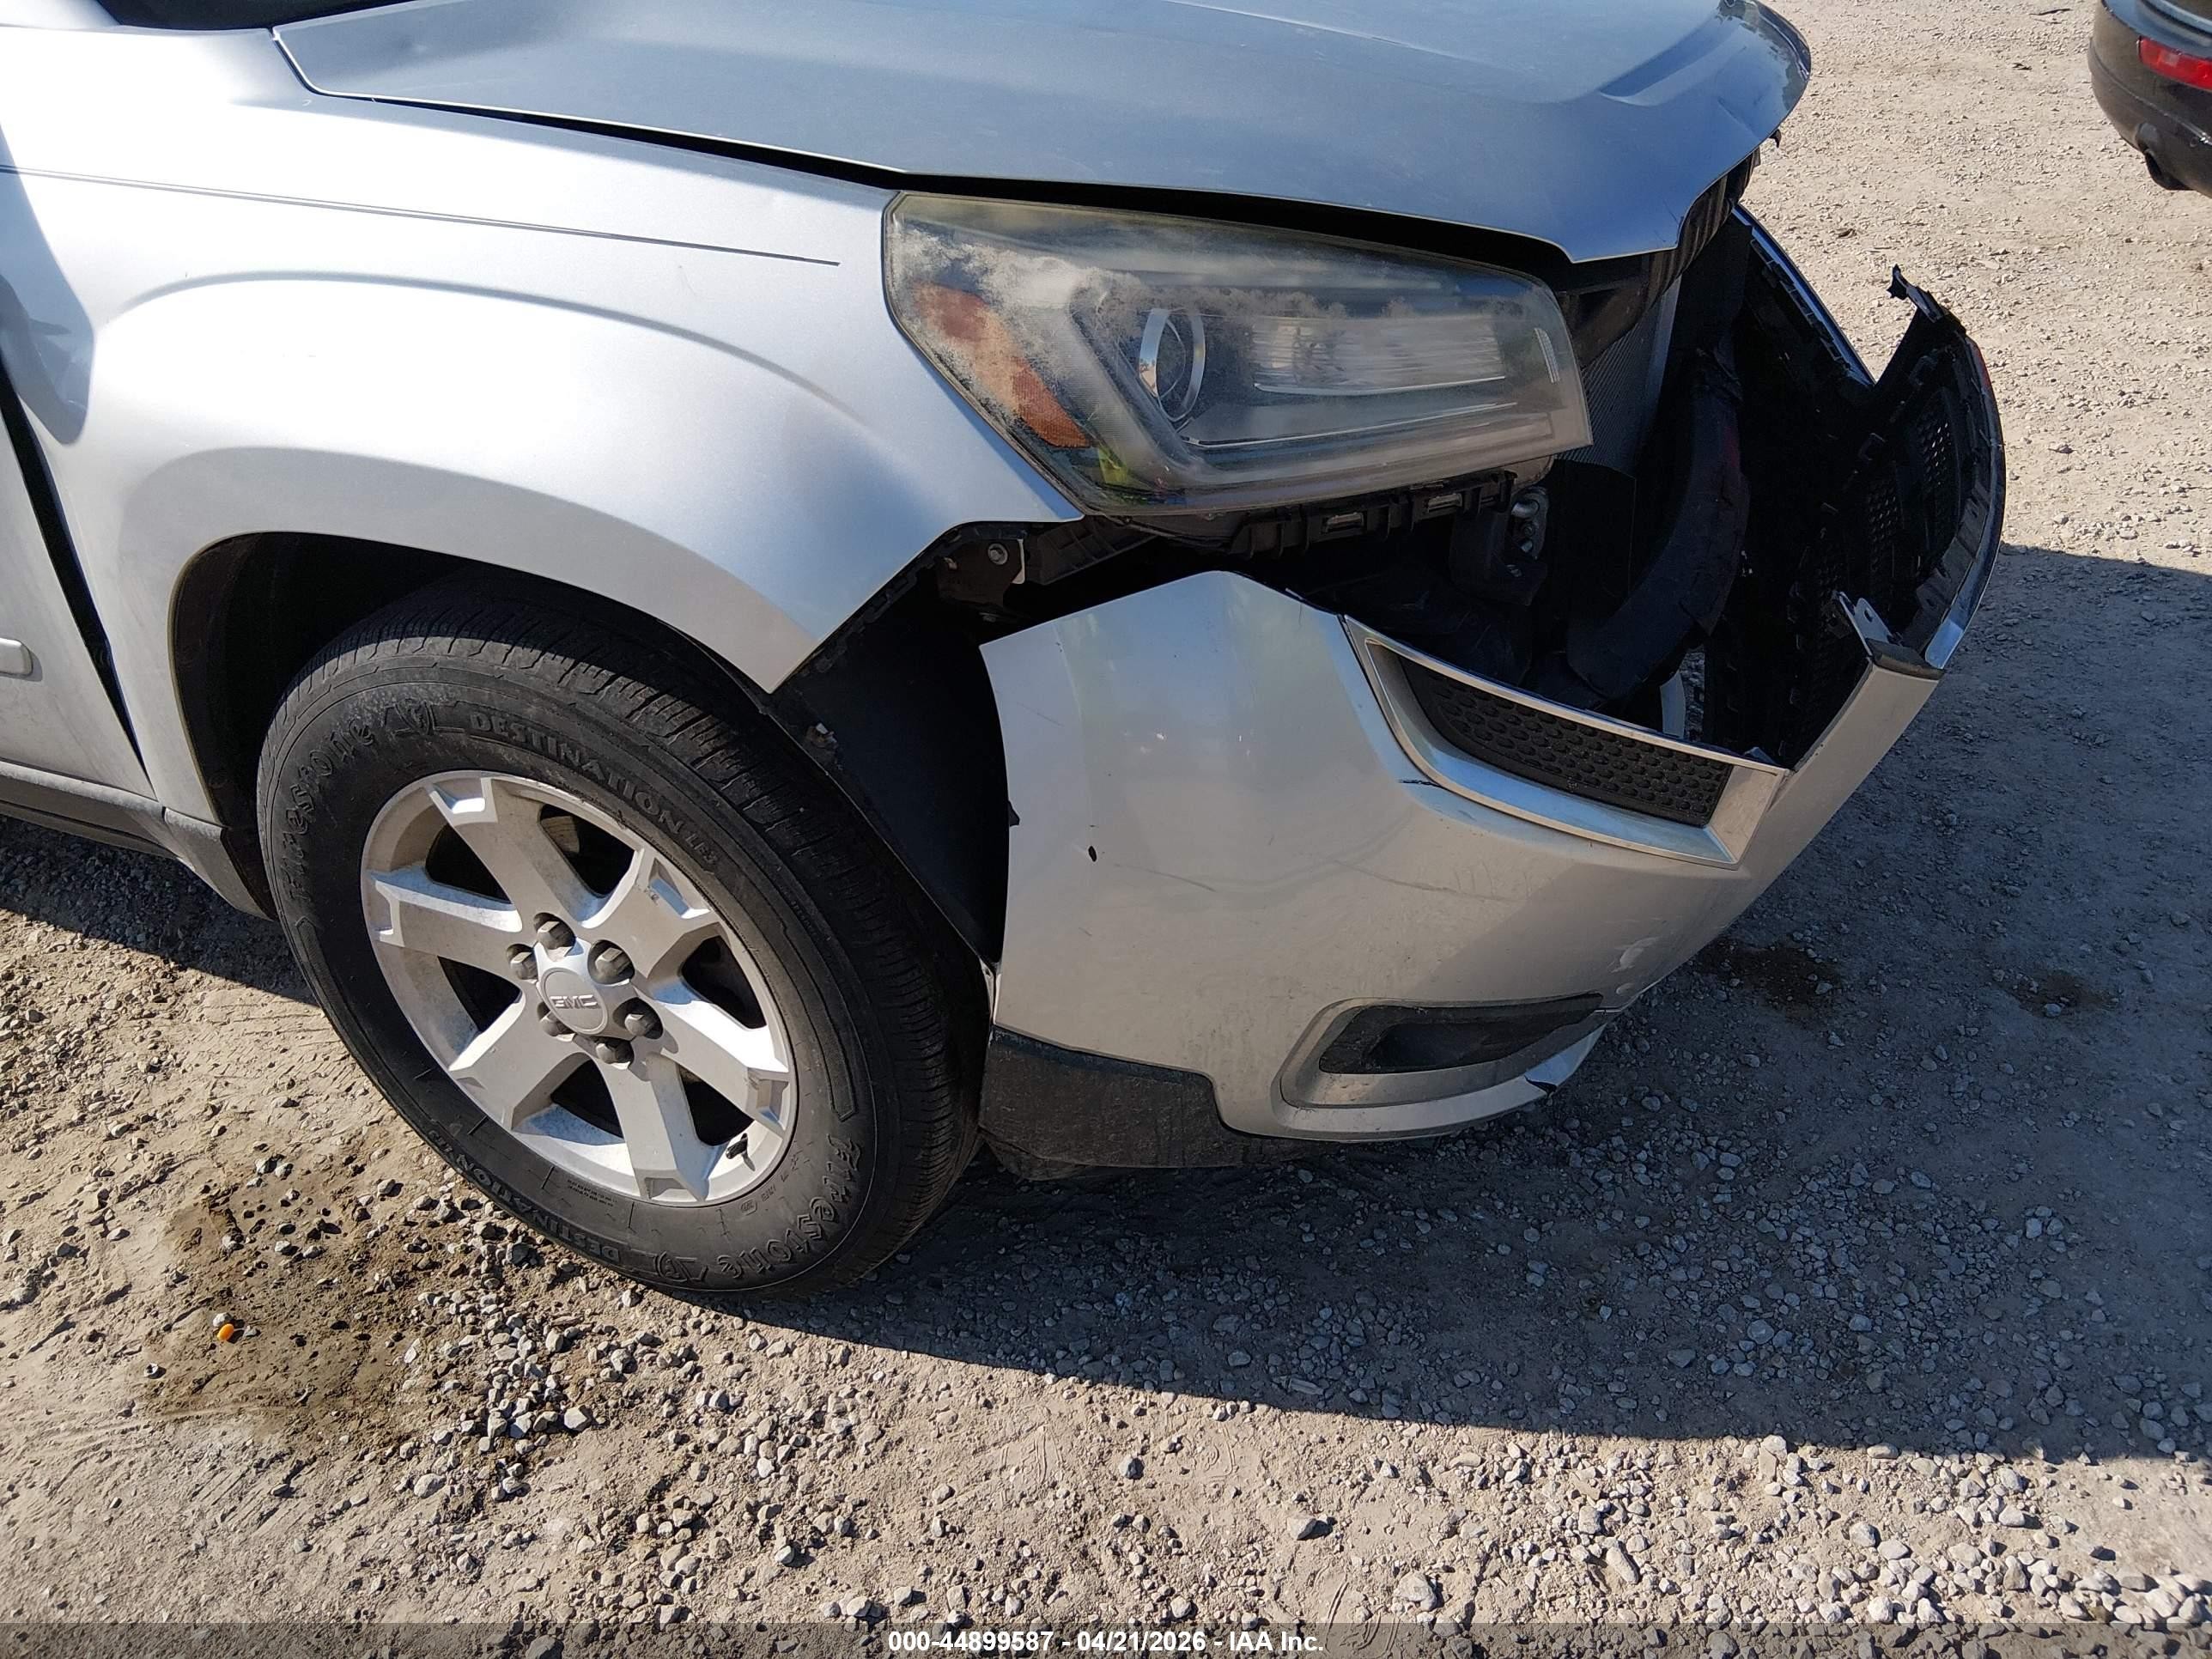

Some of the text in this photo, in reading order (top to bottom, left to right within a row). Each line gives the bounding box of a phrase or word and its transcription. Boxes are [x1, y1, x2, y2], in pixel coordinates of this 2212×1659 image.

[470, 711, 684, 835] DESTINATION
[550, 994, 599, 1010] GMC
[455, 1153, 621, 1262] DESTINATION
[716, 1133, 861, 1278] Firestone
